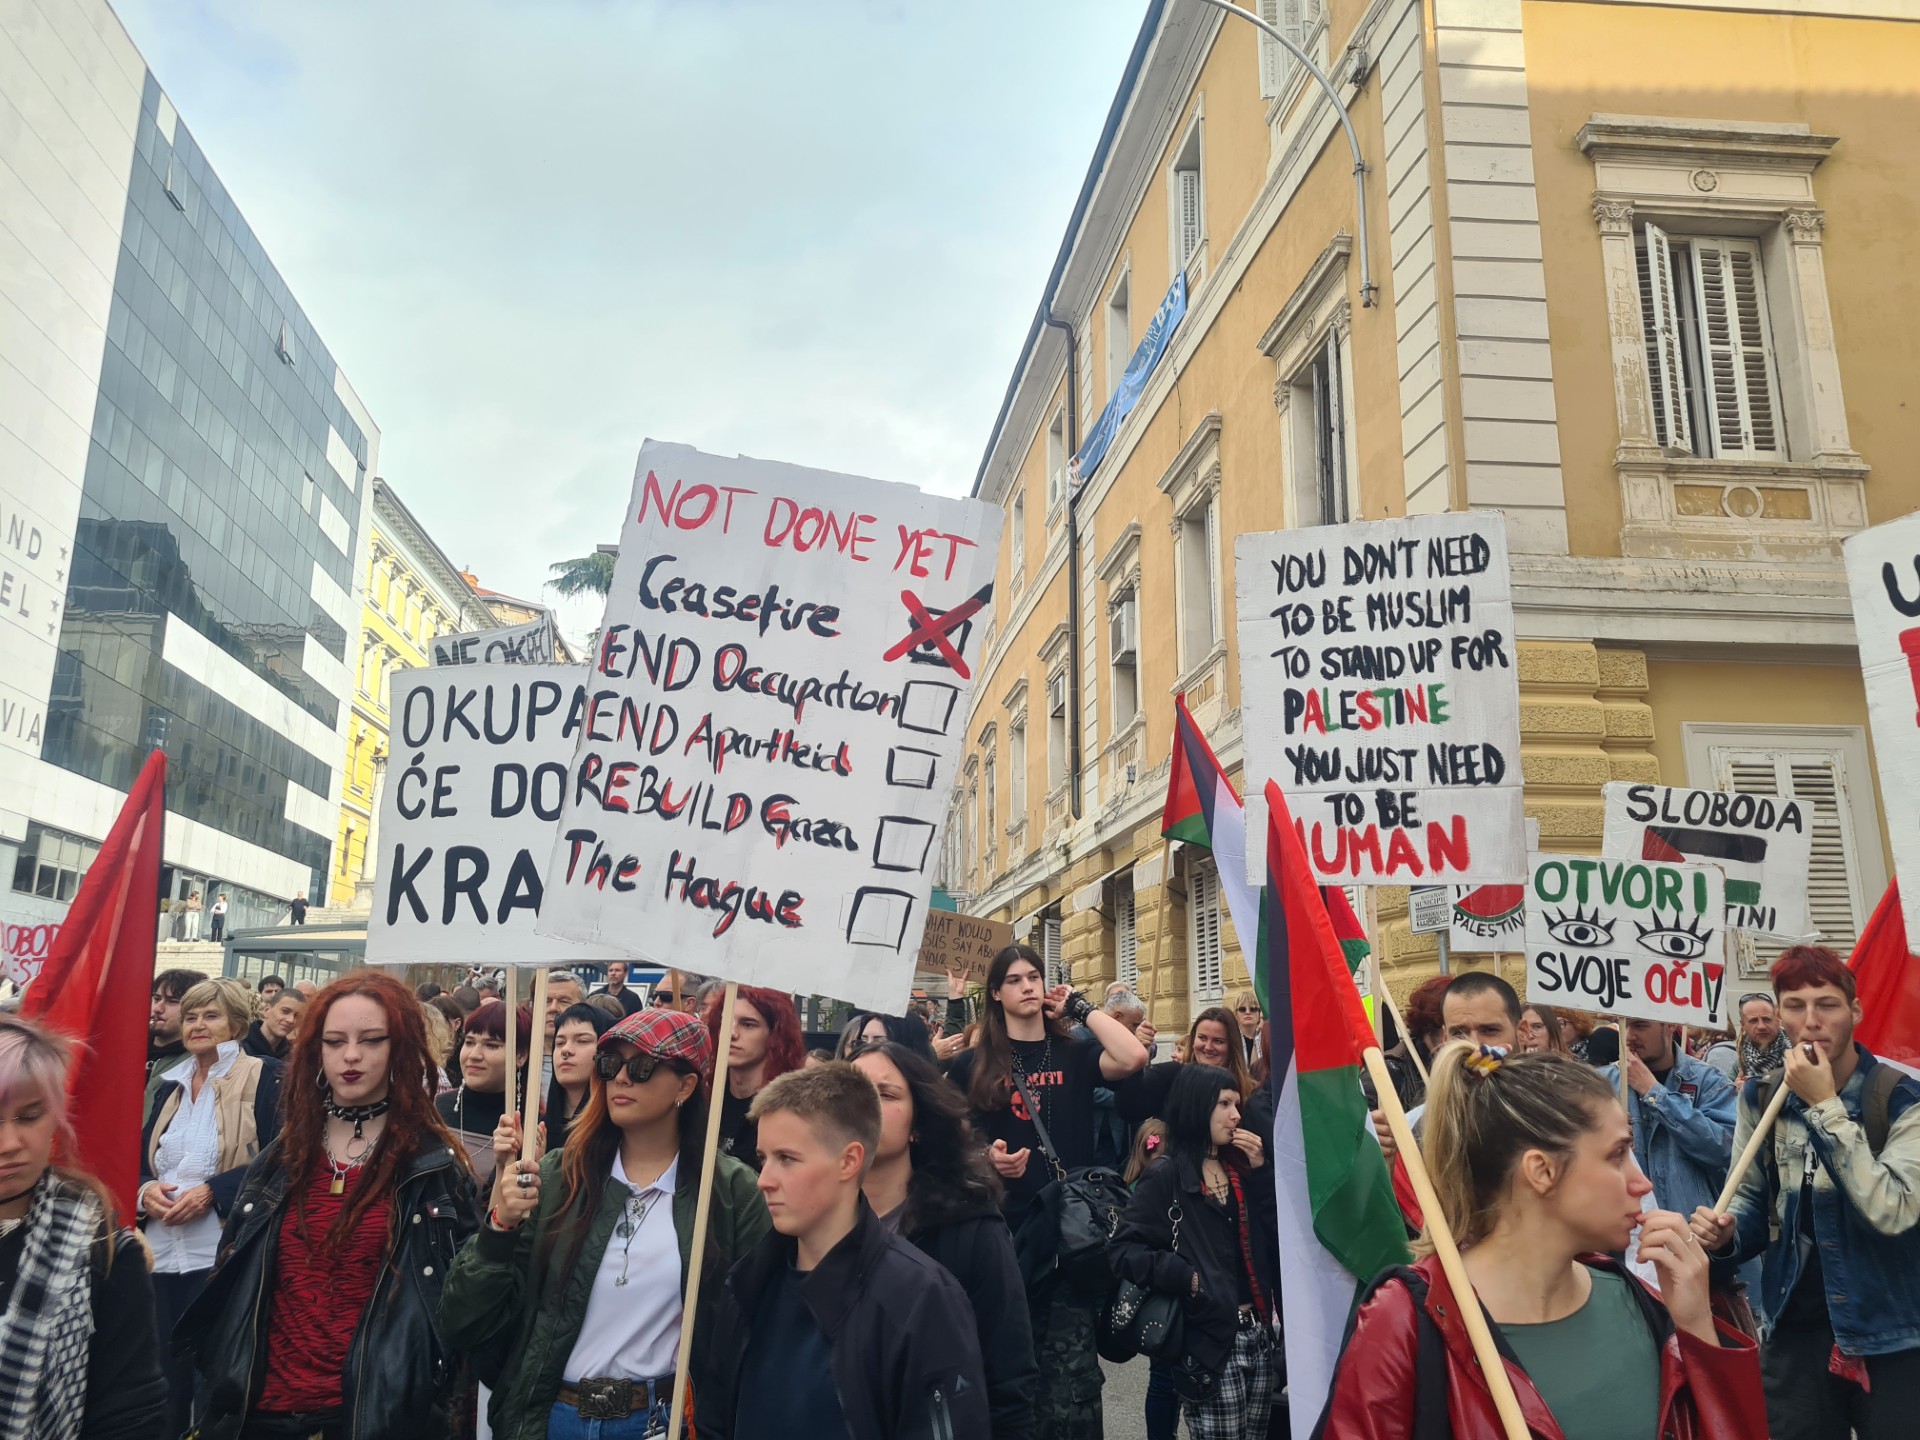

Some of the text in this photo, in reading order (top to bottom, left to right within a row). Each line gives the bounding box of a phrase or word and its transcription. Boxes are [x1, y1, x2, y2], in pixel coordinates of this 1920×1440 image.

[637, 469, 979, 581] NOT DONE YET
[1270, 532, 1491, 595] YOU DON'T NEED
[638, 554, 842, 638] Ceasefire
[1269, 584, 1471, 639] TO BE MUSLIM
[434, 637, 480, 666] NE
[599, 624, 901, 724] END Occupation
[1270, 629, 1510, 681] TO STAND UP FOR
[586, 690, 853, 777] END Apartheid
[1283, 682, 1451, 735] PALESTINE
[396, 750, 461, 821] ĆE
[1284, 742, 1506, 786] YOU JUST NEED
[575, 752, 753, 835] REBUILD
[1323, 788, 1422, 830] TO BE
[1625, 784, 1803, 834] SLOBODA
[564, 828, 805, 939] The Hague
[1534, 860, 1708, 915] OTVORI
[952, 937, 972, 955] SAY
[958, 921, 992, 942] WOULD
[922, 950, 947, 969] YOUR
[1535, 951, 1633, 1008] SVOJE
